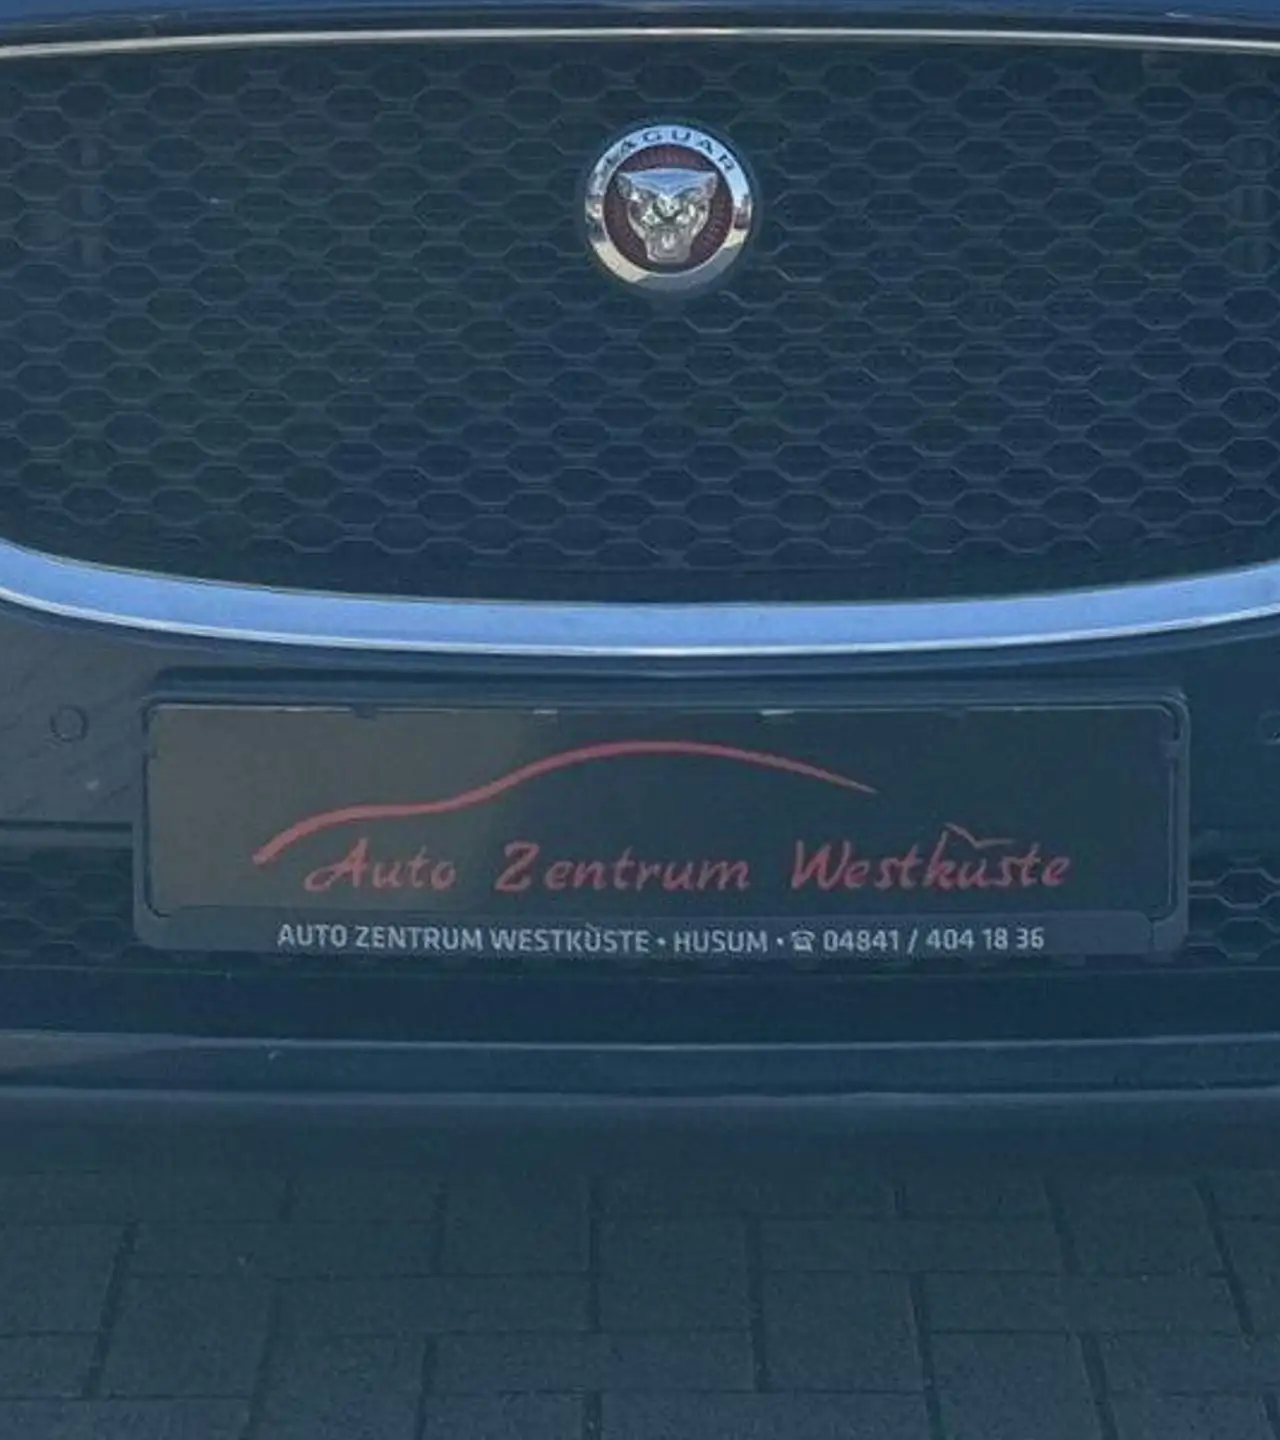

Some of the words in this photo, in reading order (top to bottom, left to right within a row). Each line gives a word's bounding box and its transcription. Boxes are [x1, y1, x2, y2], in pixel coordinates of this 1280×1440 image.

[303, 837, 458, 892] Auto
[494, 841, 751, 892] Zentrum
[276, 922, 348, 949] AUTO
[354, 925, 483, 951] ZENTRUM
[489, 920, 651, 953] WESTKÜSTE
[673, 930, 769, 953] HUSUM
[822, 929, 900, 953] 04841
[924, 928, 975, 952] 404
[982, 927, 1009, 951] 18
[1015, 927, 1045, 950] 36
